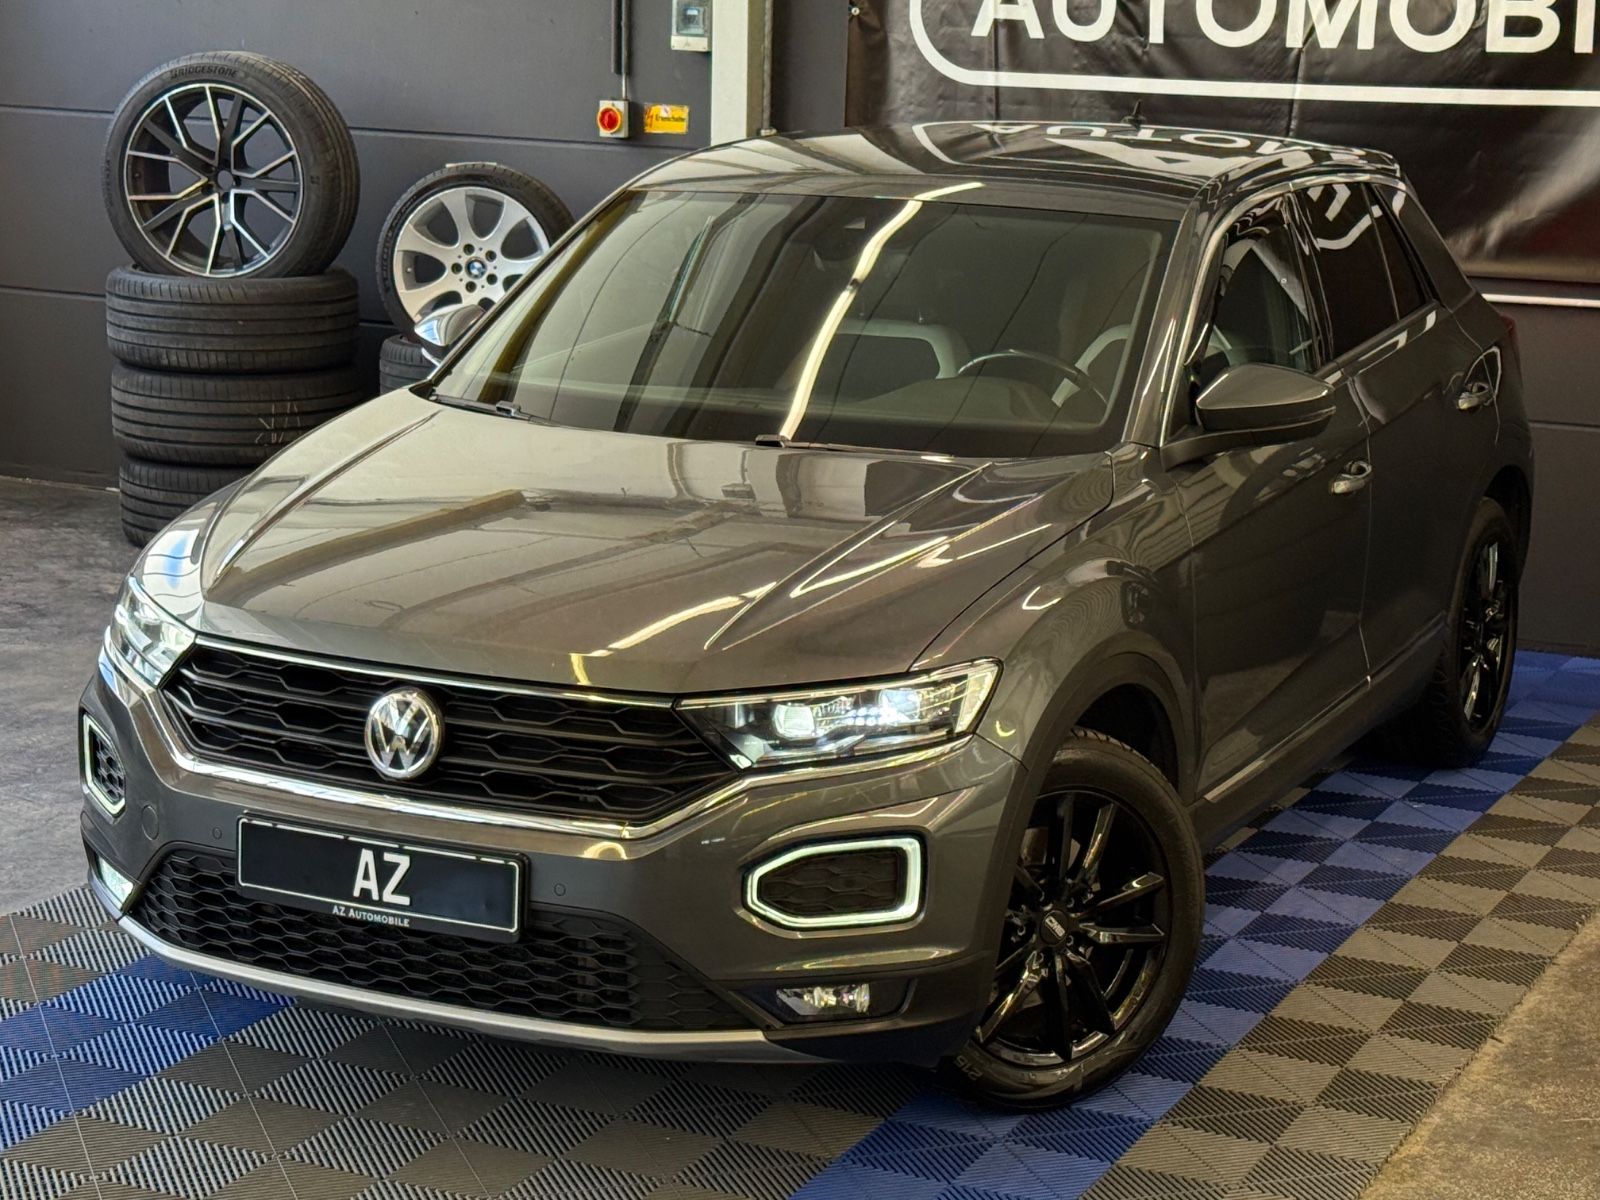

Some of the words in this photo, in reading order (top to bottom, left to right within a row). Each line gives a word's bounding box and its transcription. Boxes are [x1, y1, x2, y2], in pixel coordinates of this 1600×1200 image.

[171, 66, 238, 80] BRIDGESTONE
[367, 689, 437, 775] VW
[353, 848, 411, 906] AZ
[332, 905, 346, 917] AZ
